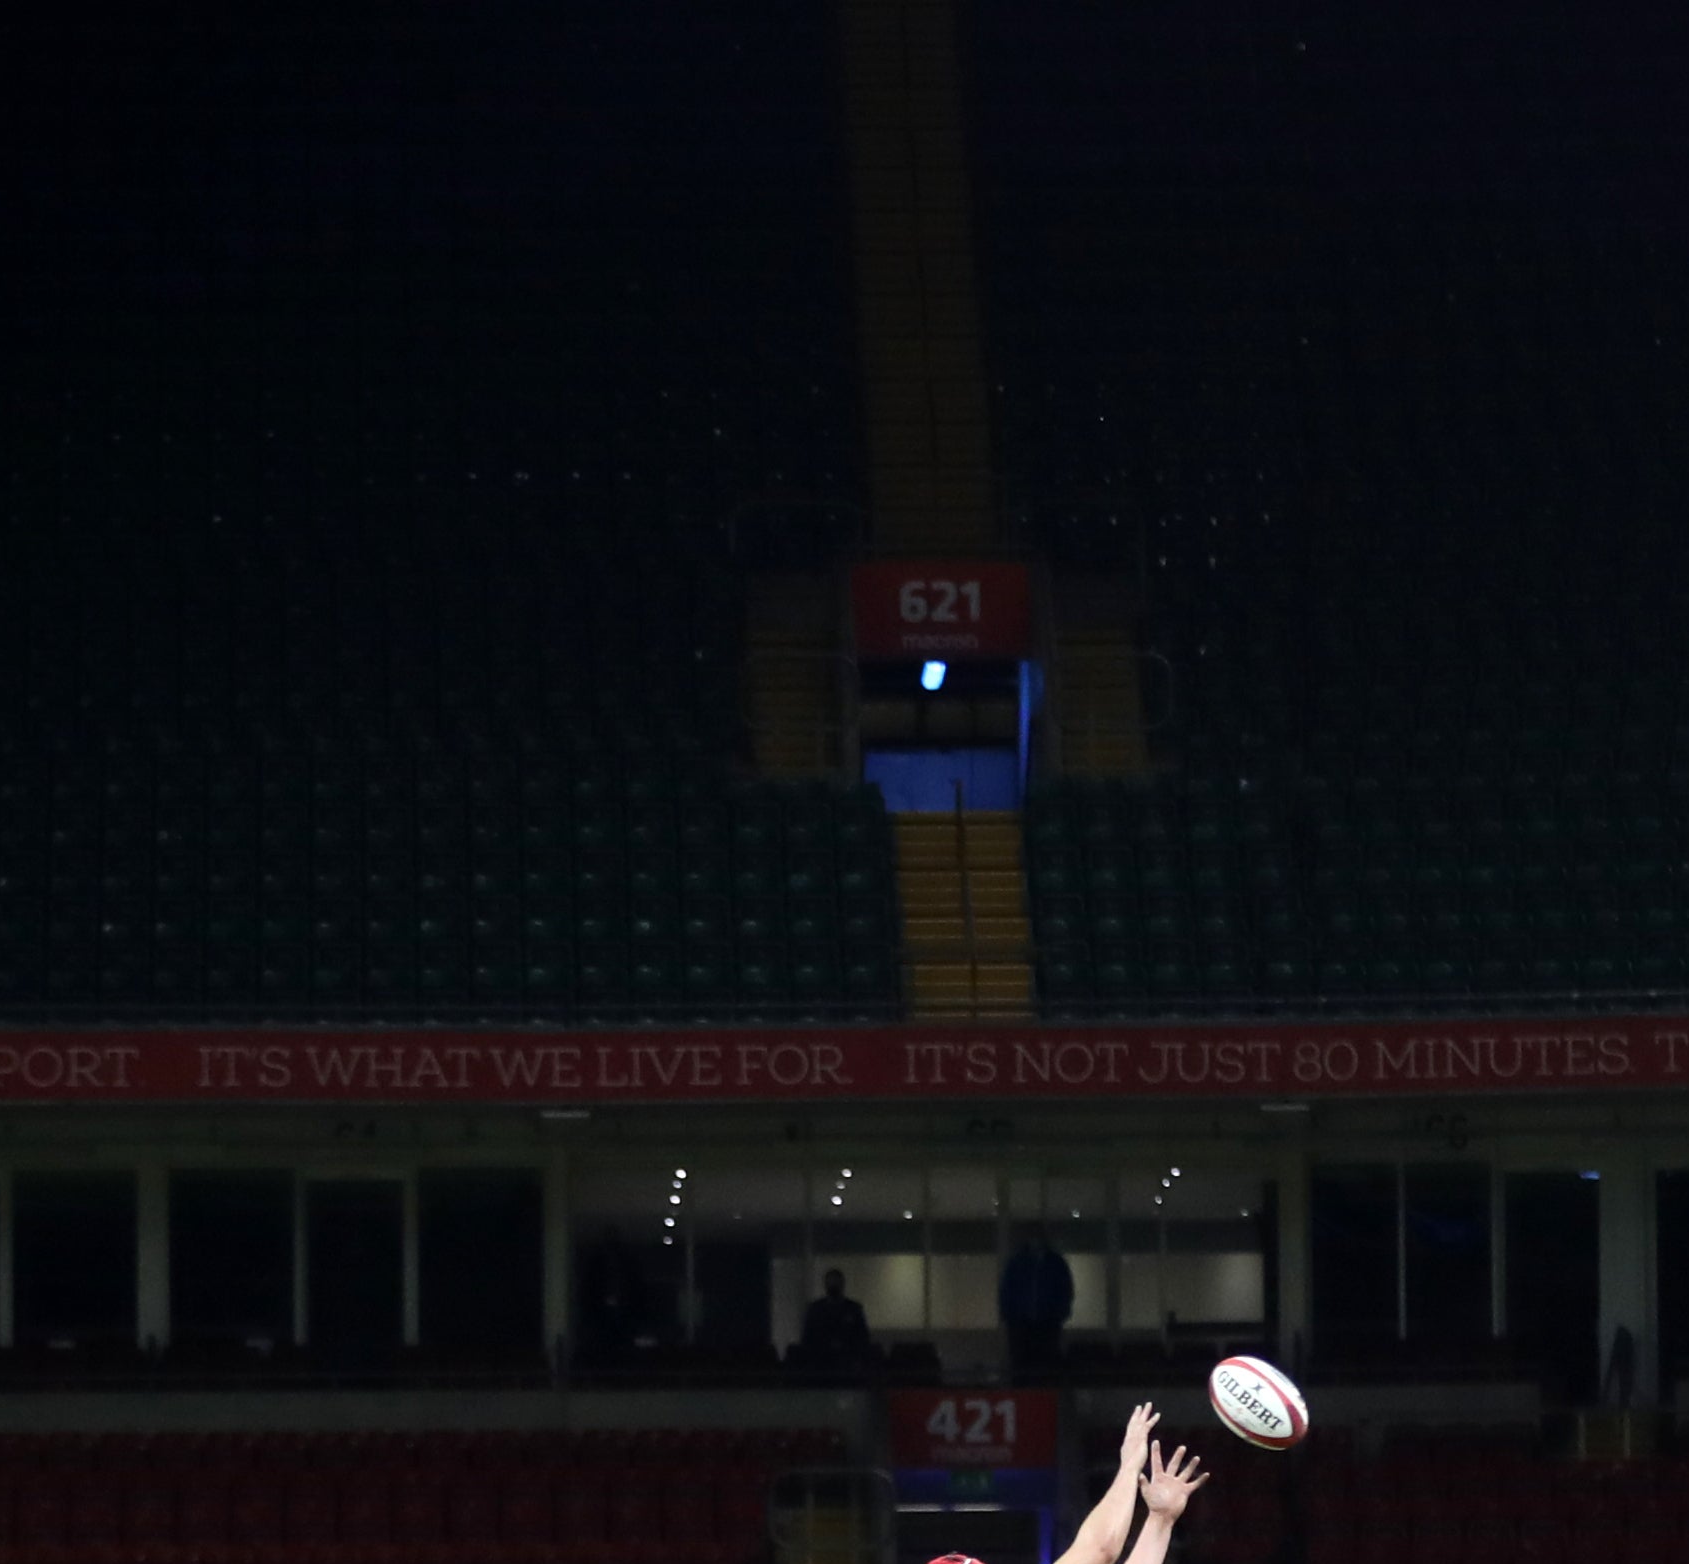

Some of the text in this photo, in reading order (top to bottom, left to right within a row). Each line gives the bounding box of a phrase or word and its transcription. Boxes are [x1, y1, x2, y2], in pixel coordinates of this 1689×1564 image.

[899, 579, 982, 623] 621
[197, 1046, 292, 1089] IT'S
[308, 1047, 485, 1088] WHAT
[491, 1047, 581, 1088] WE
[594, 1046, 722, 1087] LIVE
[904, 1042, 997, 1085] IT'S
[1011, 1043, 1129, 1085] NOT
[1138, 1041, 1281, 1085] JUST
[1292, 1041, 1360, 1083] 80
[925, 1397, 1018, 1444] 421
[1218, 1370, 1284, 1430] GILBERT
